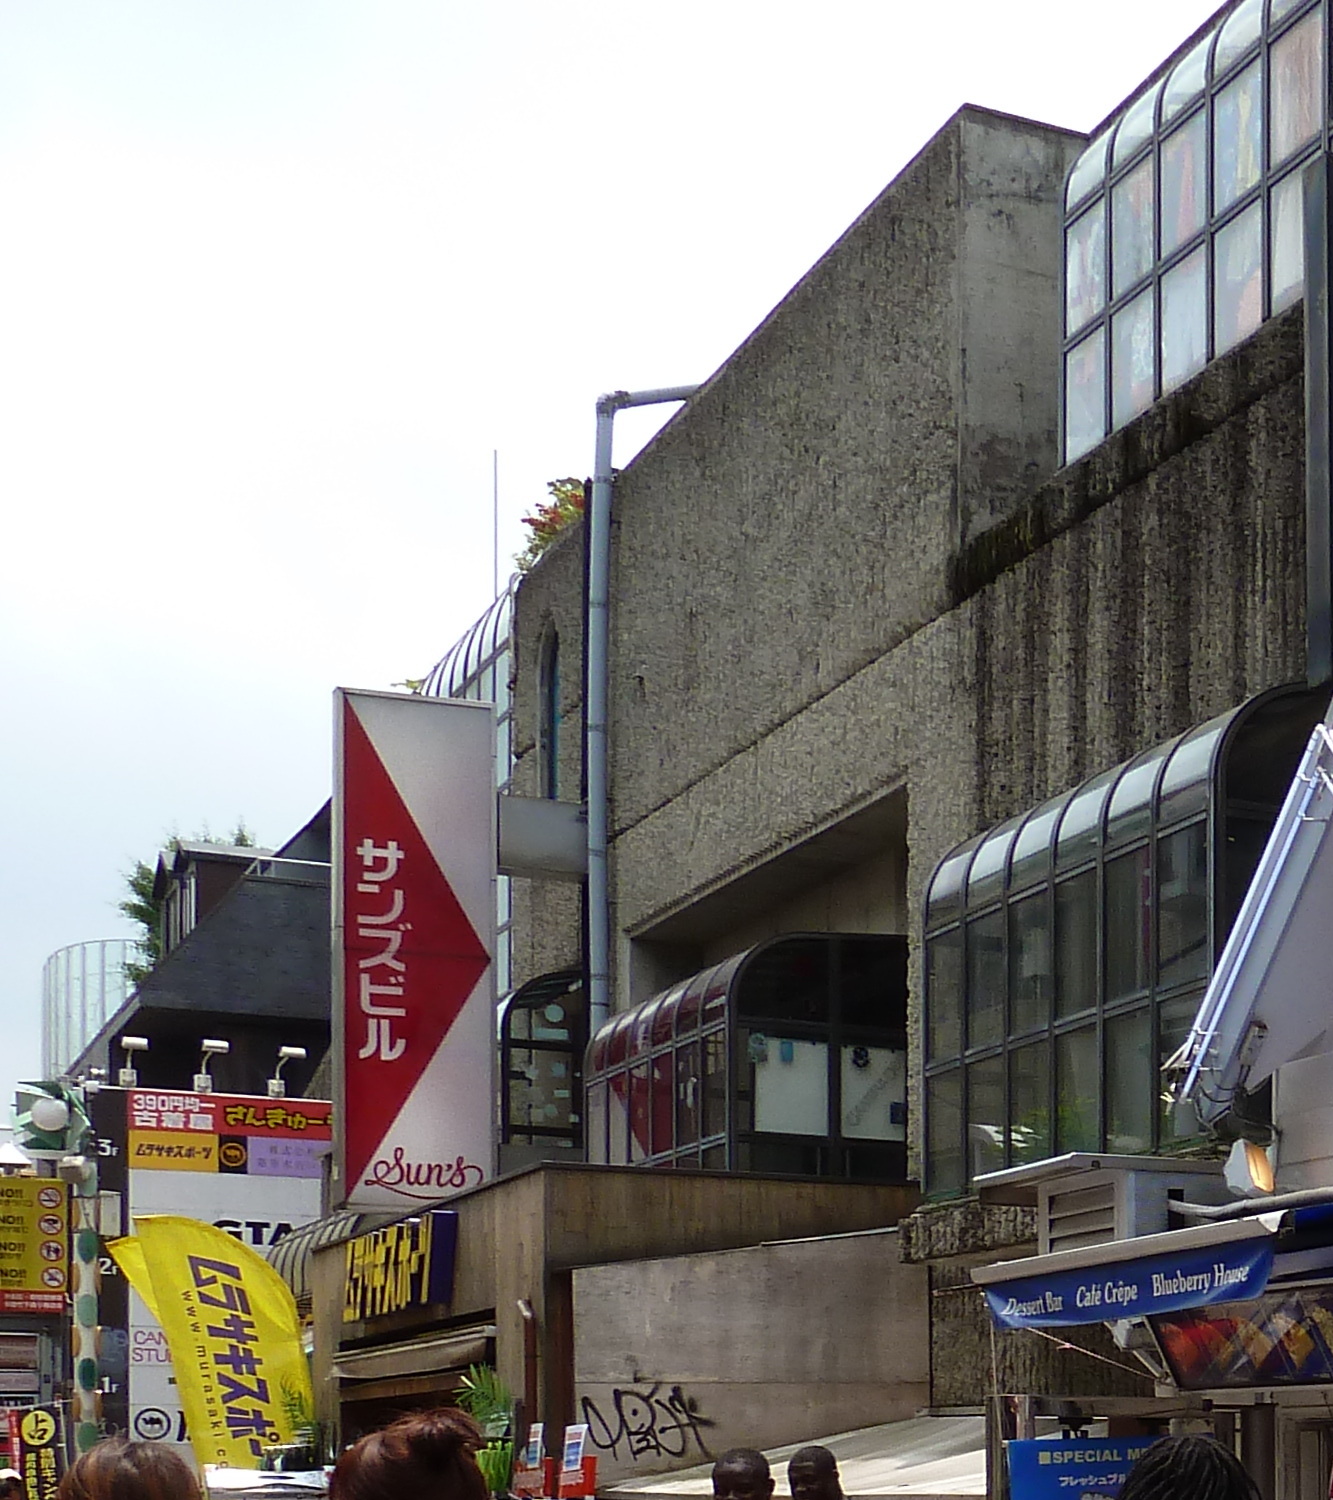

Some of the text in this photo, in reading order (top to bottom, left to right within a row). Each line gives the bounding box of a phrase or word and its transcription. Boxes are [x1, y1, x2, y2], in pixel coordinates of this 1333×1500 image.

[355, 837, 407, 1063] サンズビル
[135, 1143, 212, 1160] ムラサキスポーツ
[364, 1147, 484, 1200] Sun's
[1000, 1263, 1250, 1317] Dessert Bar Café Crêpe Blueberry House
[1052, 1449, 1123, 1465] SPECIAL
